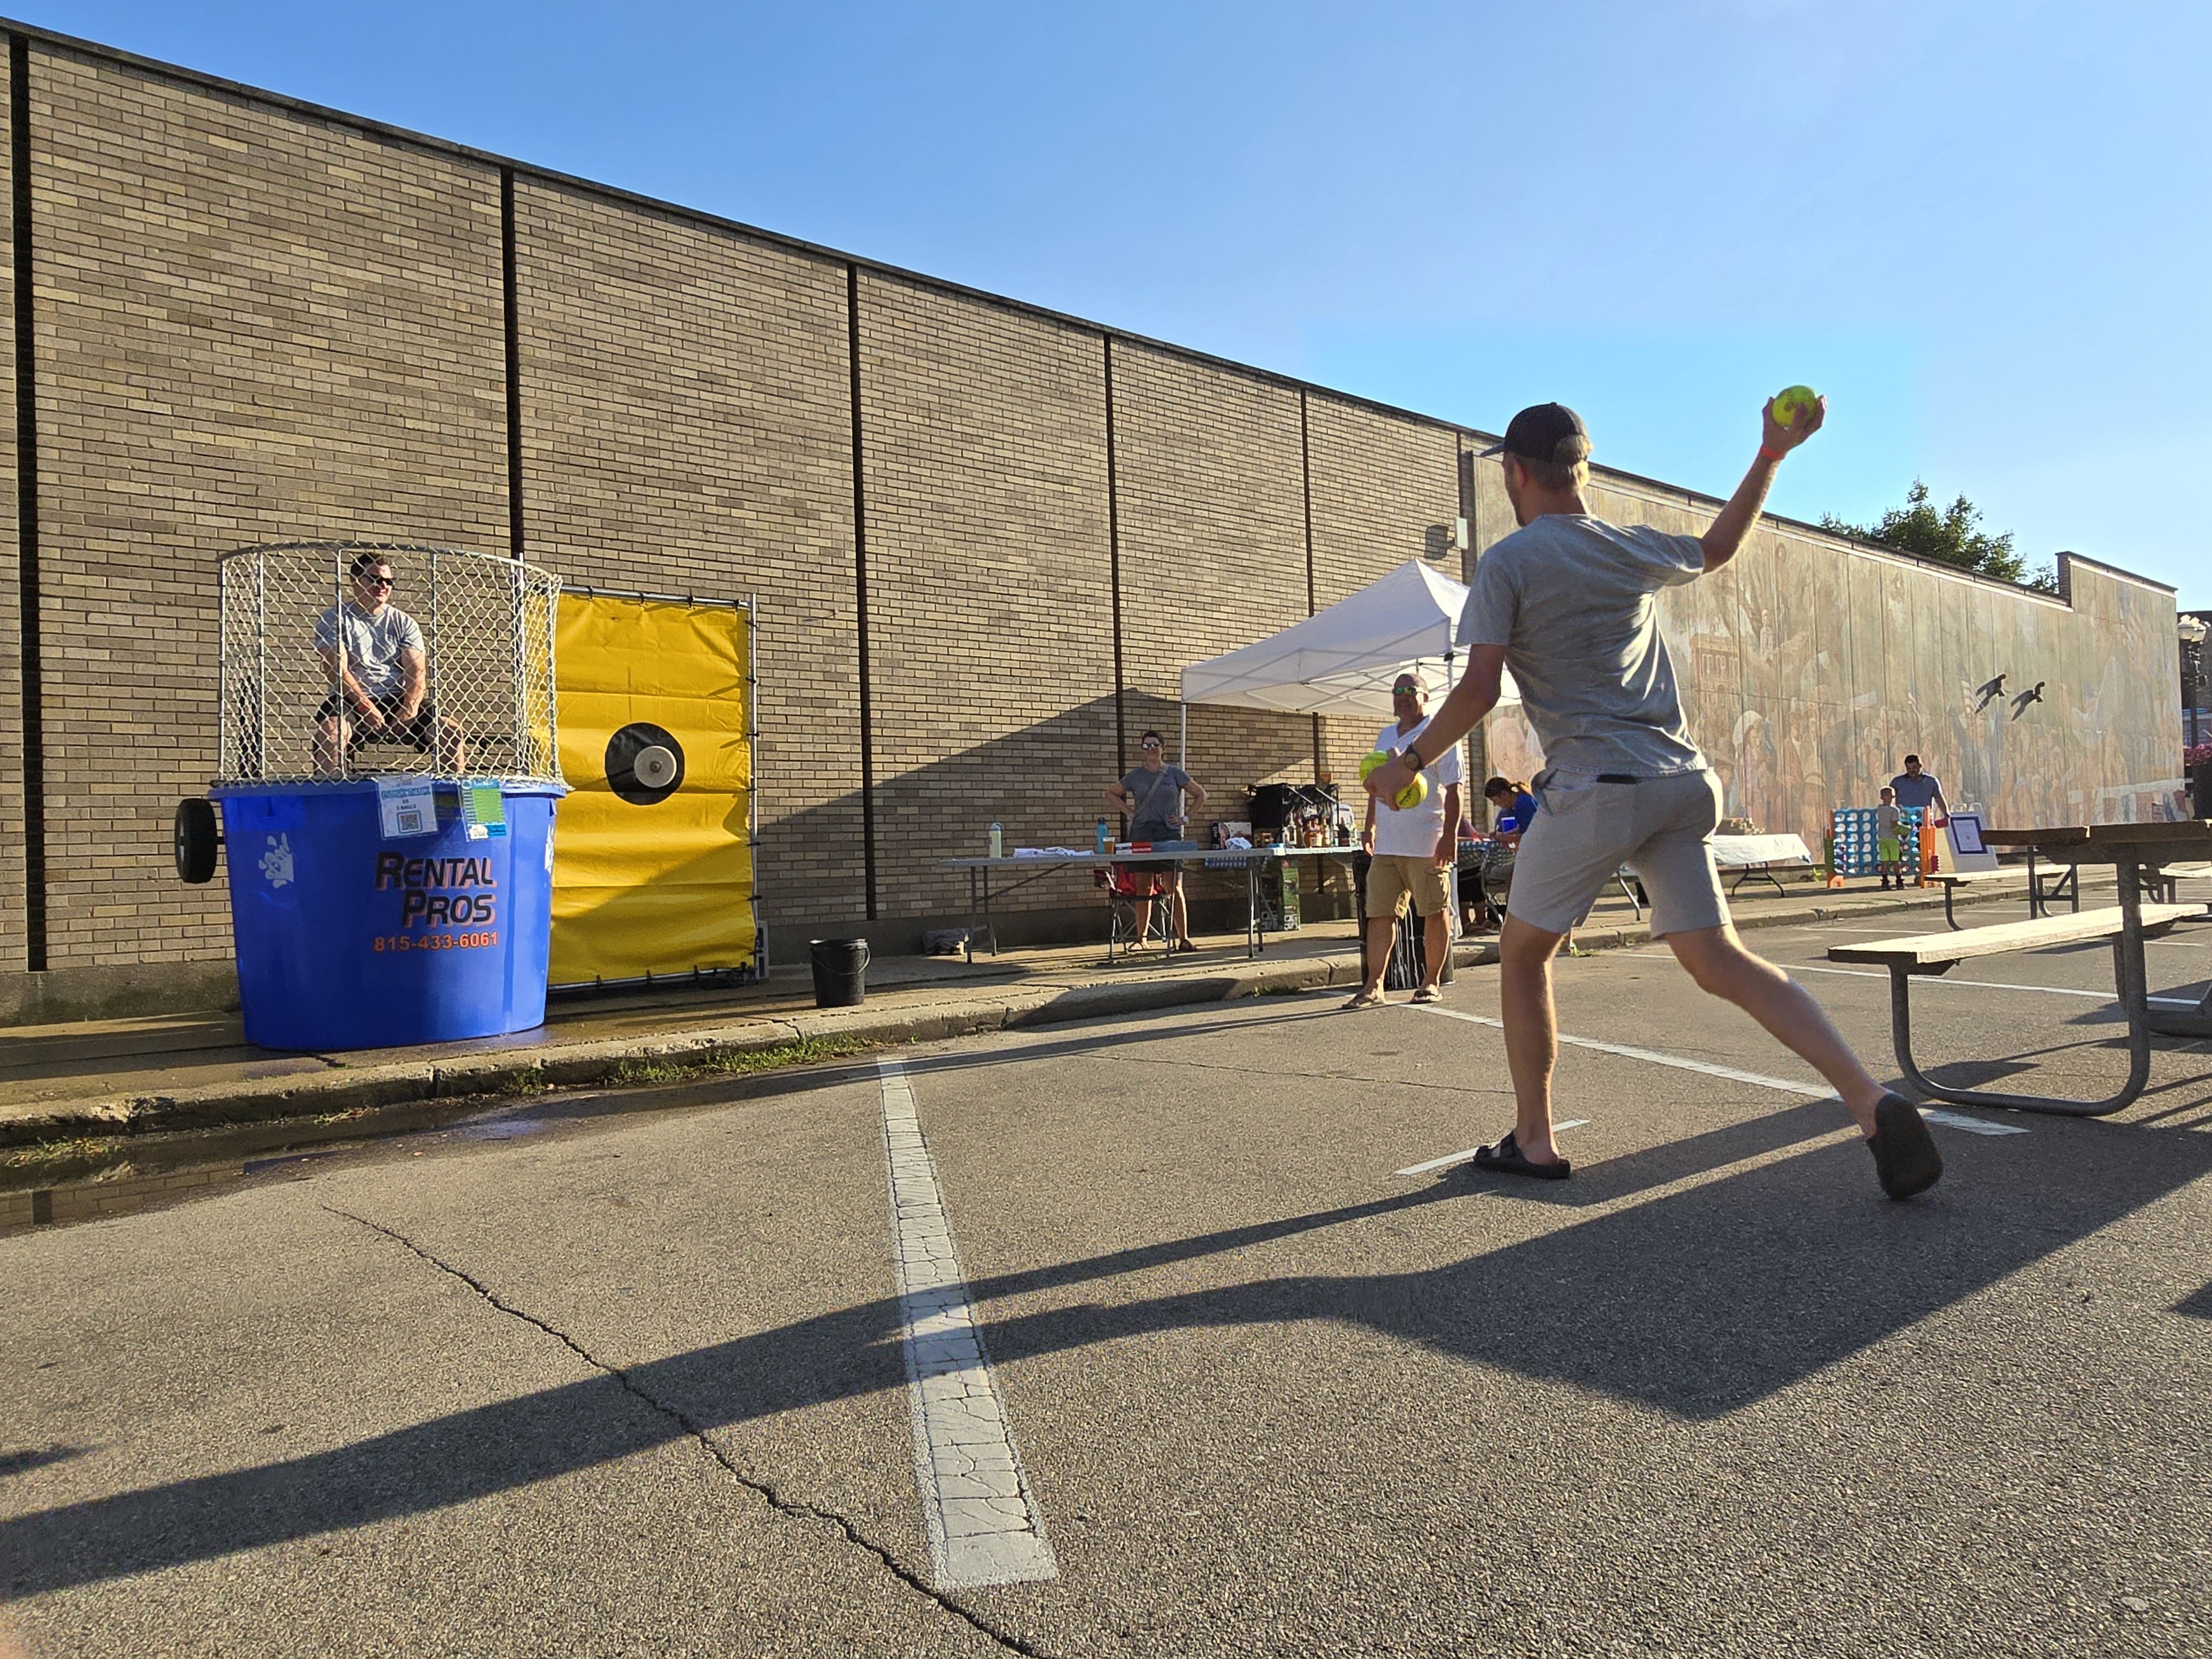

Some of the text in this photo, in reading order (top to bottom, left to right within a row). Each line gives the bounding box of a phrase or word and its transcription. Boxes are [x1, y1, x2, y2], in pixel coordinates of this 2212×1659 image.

[375, 852, 497, 890] RENTAL
[401, 889, 497, 928] PROS
[373, 931, 498, 952] 815-433-6061
